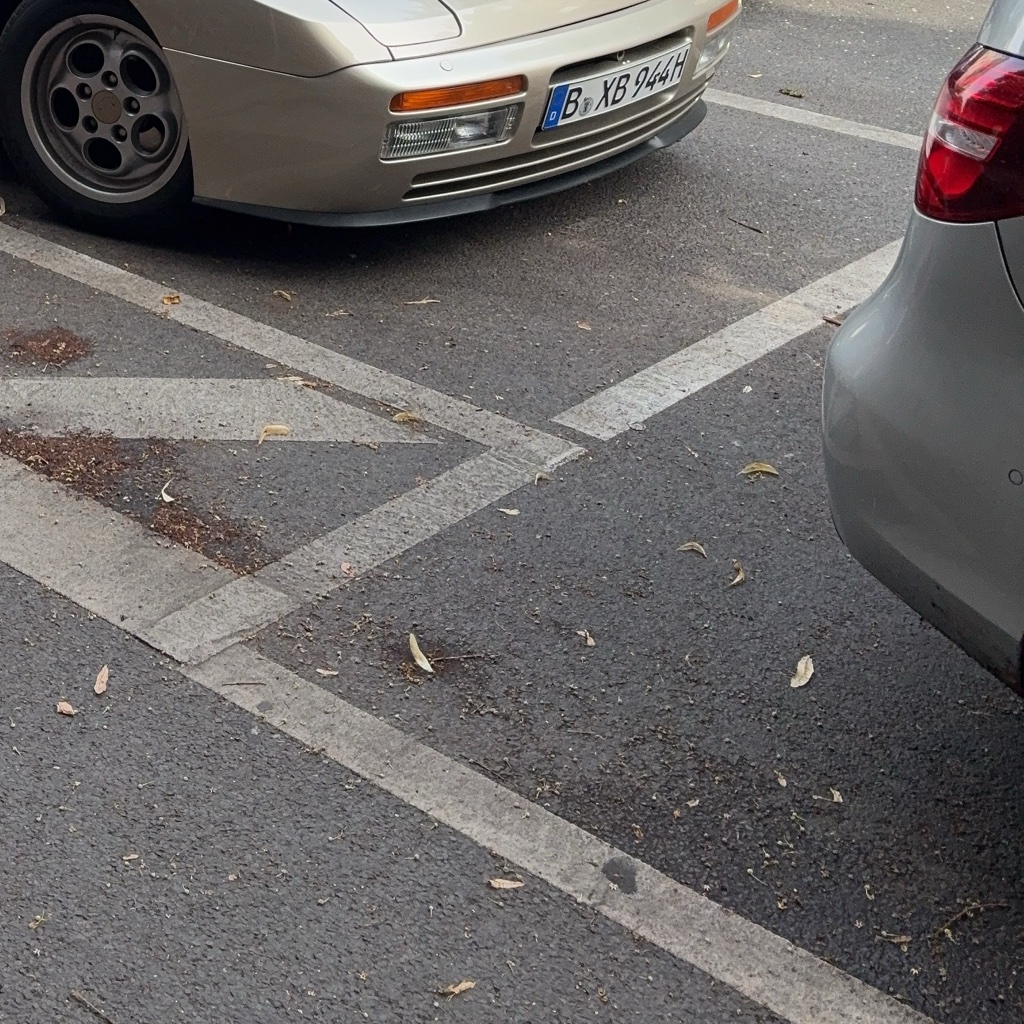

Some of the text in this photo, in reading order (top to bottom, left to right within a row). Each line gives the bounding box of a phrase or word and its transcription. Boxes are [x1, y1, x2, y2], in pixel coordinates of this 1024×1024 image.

[549, 49, 689, 121] D B XB 944H
